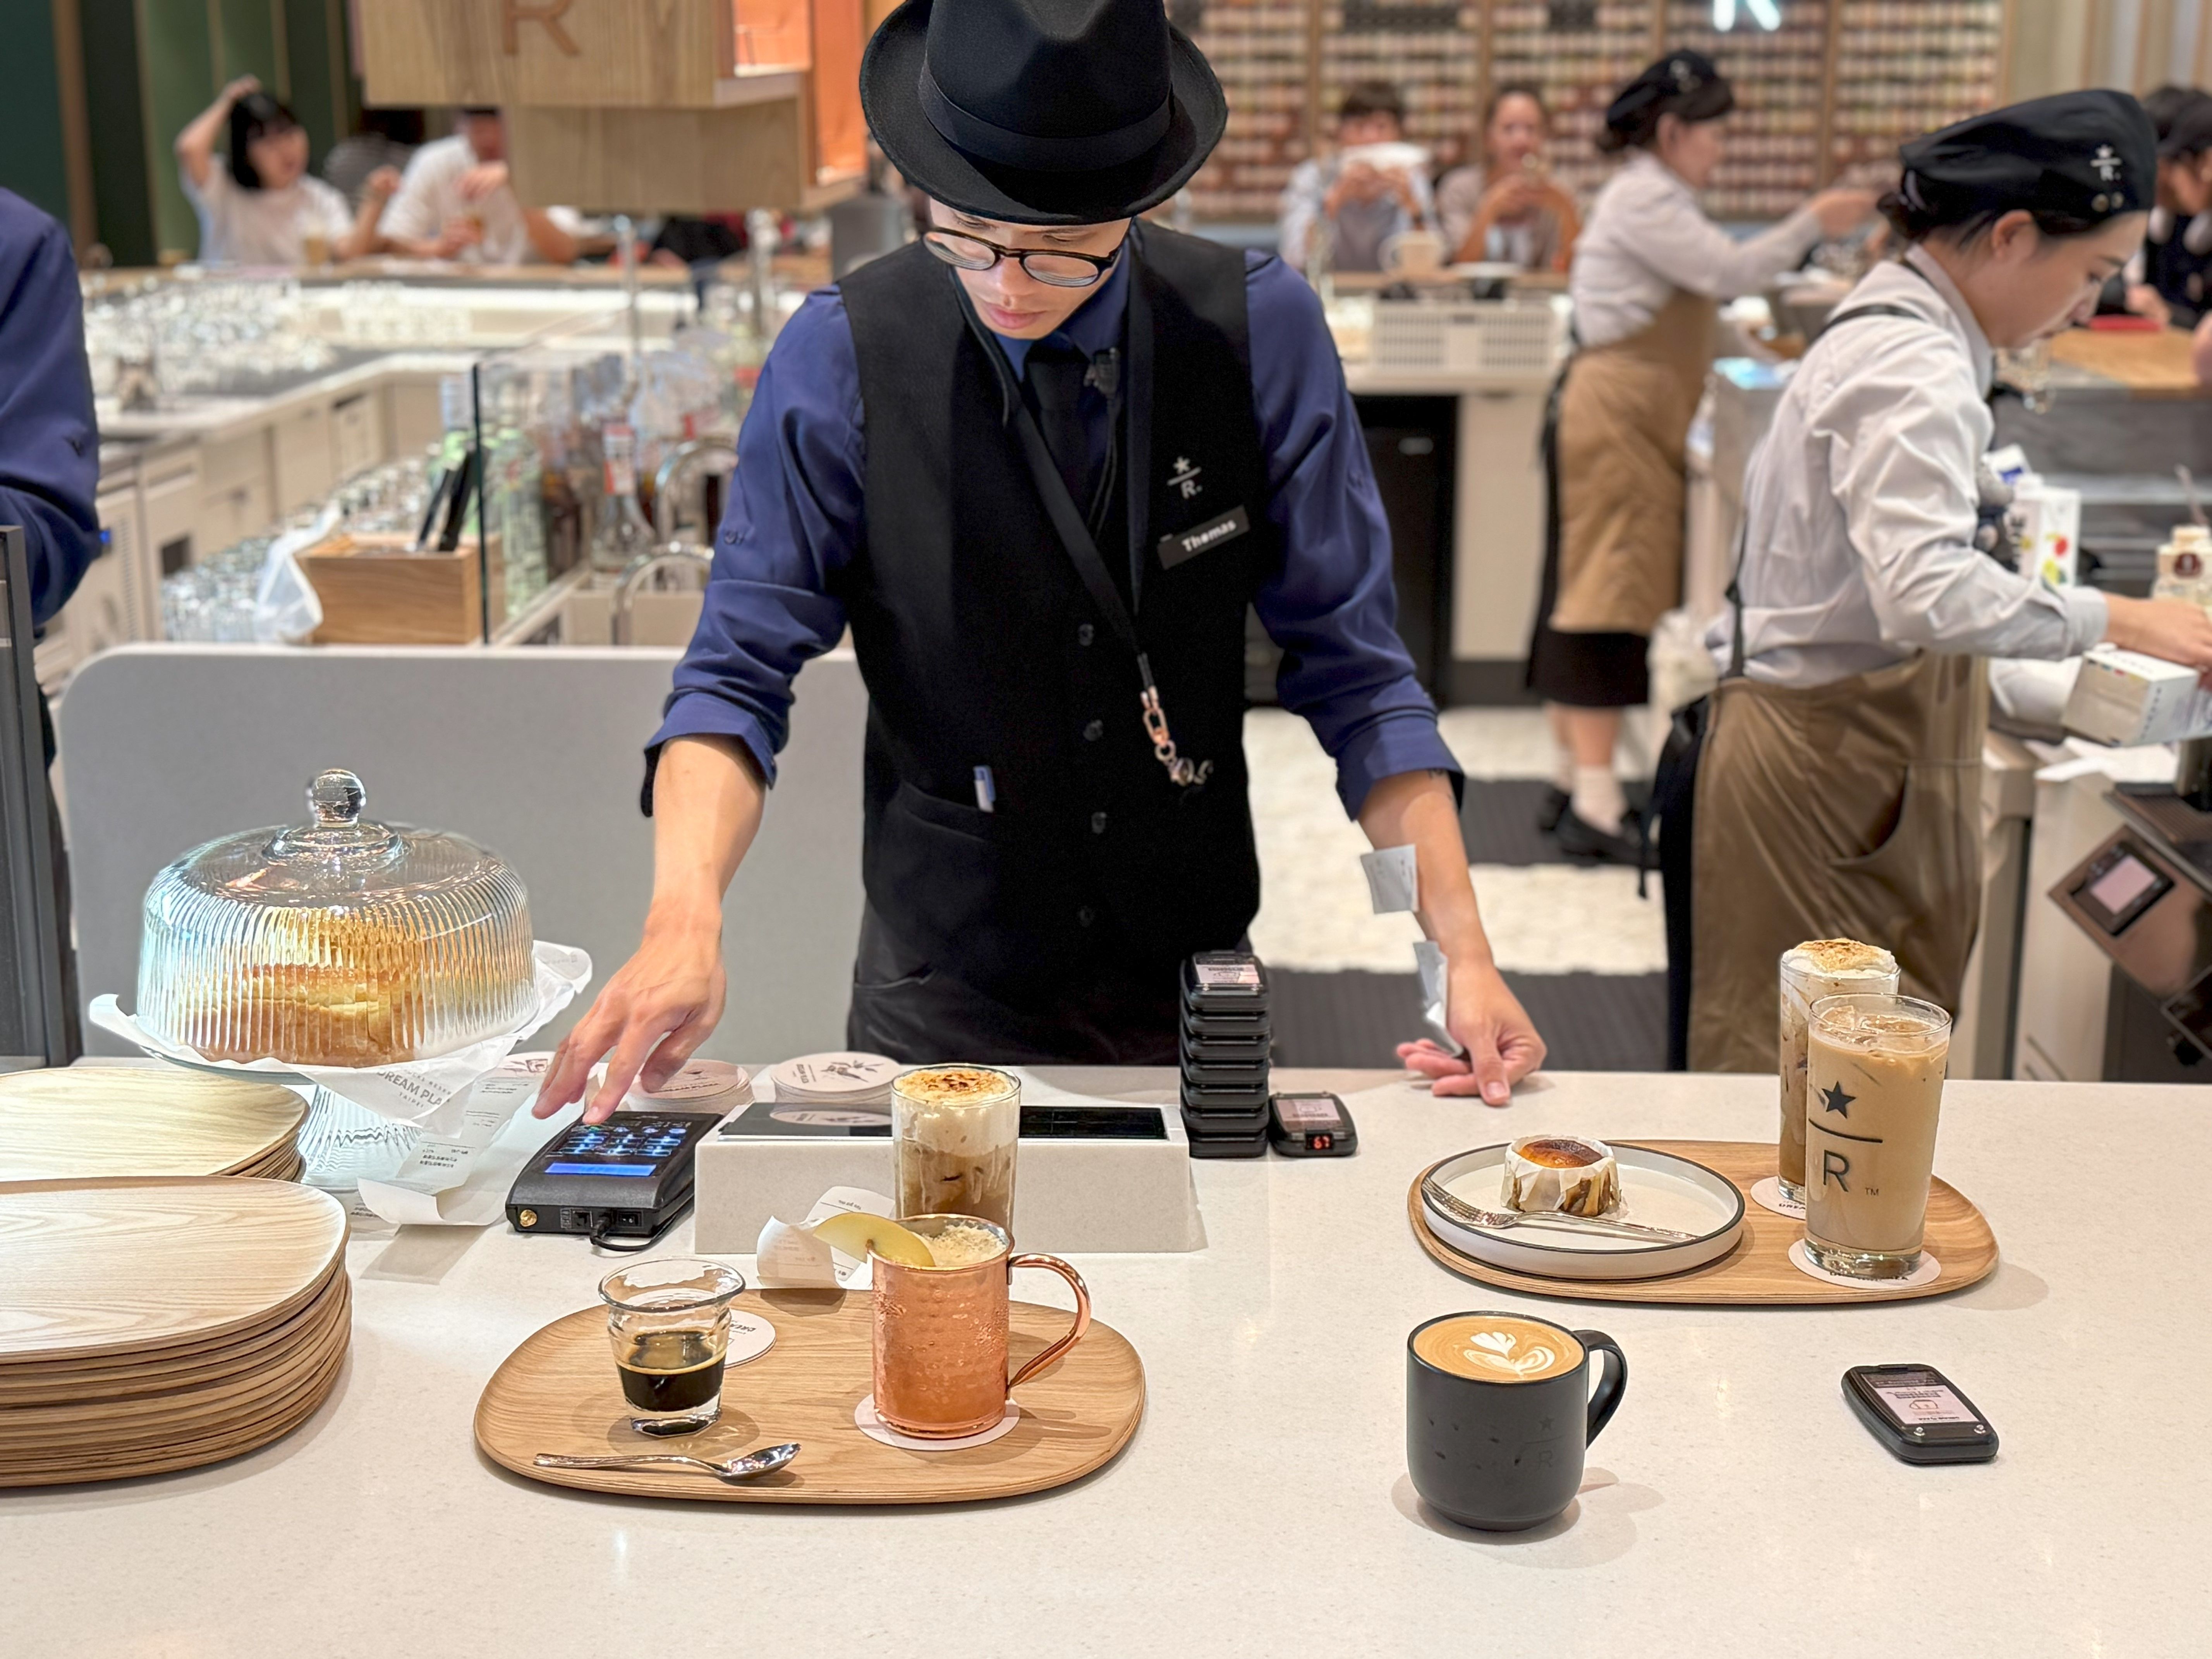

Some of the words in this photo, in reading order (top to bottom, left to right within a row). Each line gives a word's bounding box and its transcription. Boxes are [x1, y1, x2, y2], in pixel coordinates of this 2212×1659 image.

[1182, 519, 1237, 552] Thomas
[1823, 1149, 1849, 1192] R
[1865, 1187, 1879, 1196] TM
